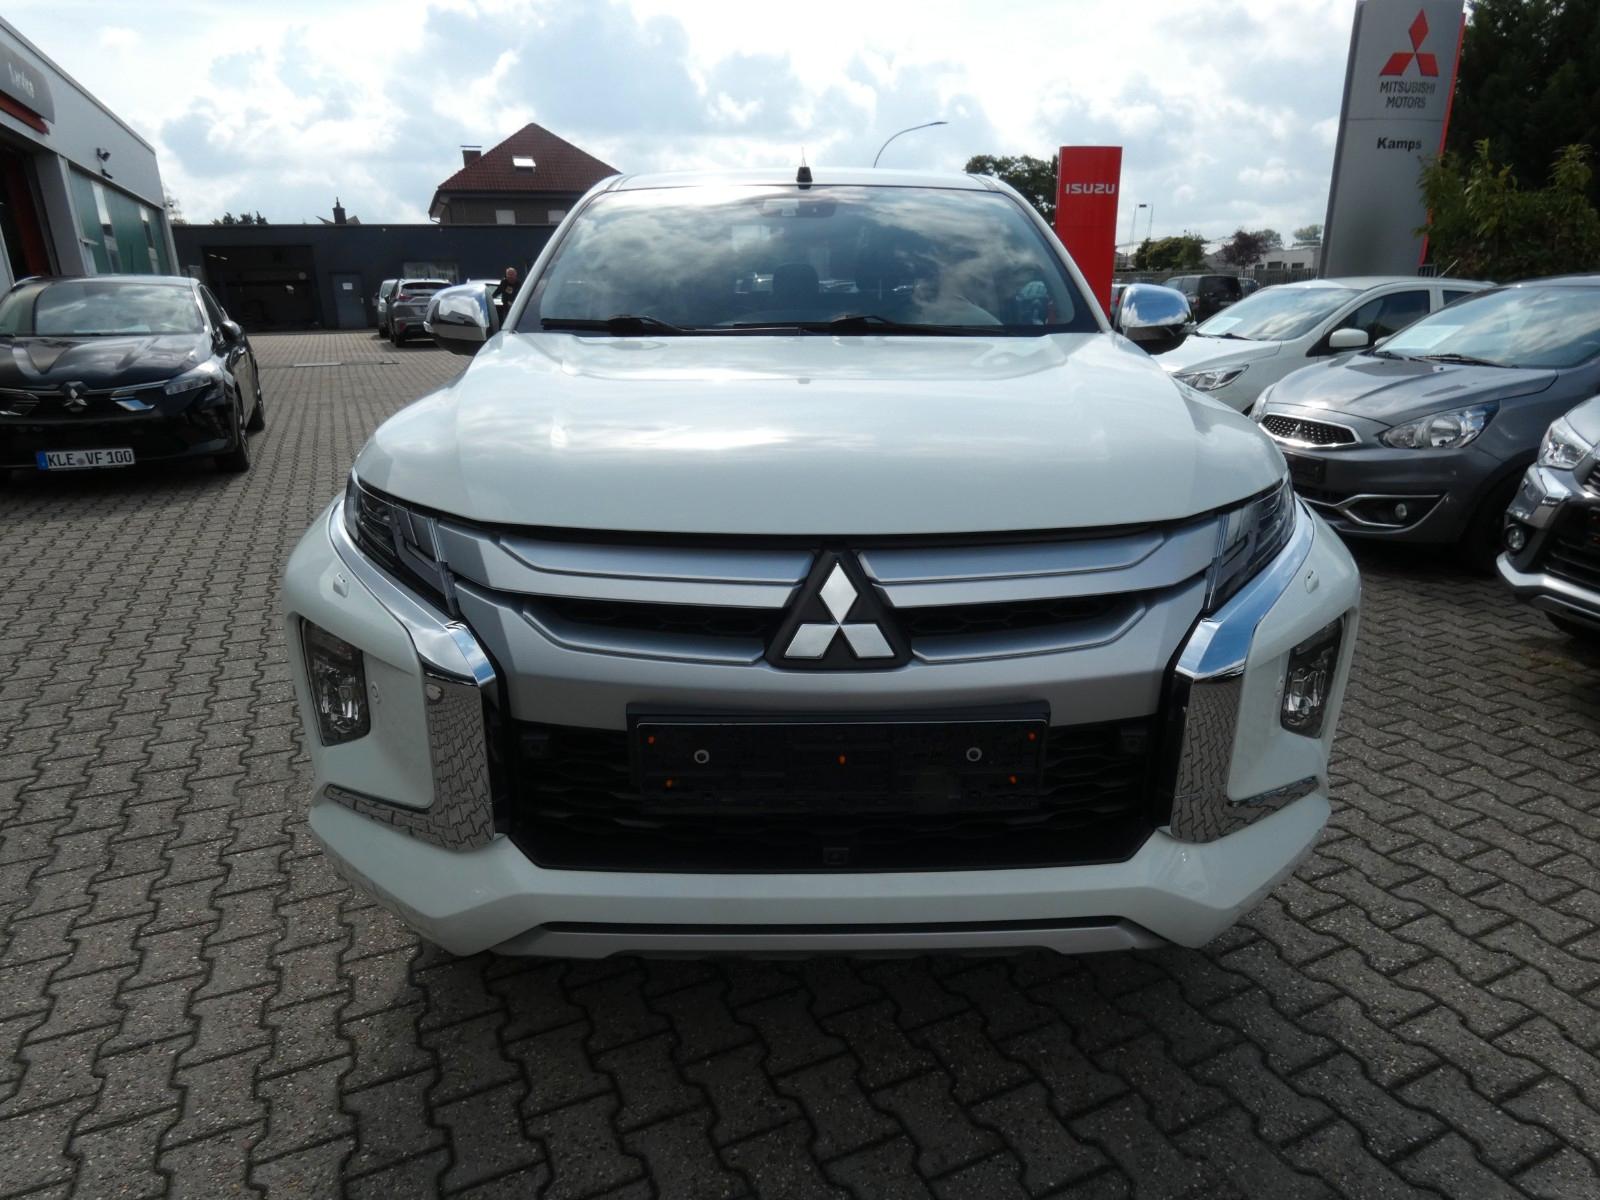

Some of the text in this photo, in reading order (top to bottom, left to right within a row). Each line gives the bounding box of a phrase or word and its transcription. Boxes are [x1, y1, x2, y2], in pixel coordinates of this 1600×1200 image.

[1379, 80, 1436, 94] MITSUBISHI
[1385, 96, 1426, 109] MOTORS
[1377, 137, 1422, 152] Kamps
[1065, 183, 1115, 194] ISUZU
[47, 450, 132, 466] KLE VF 100
